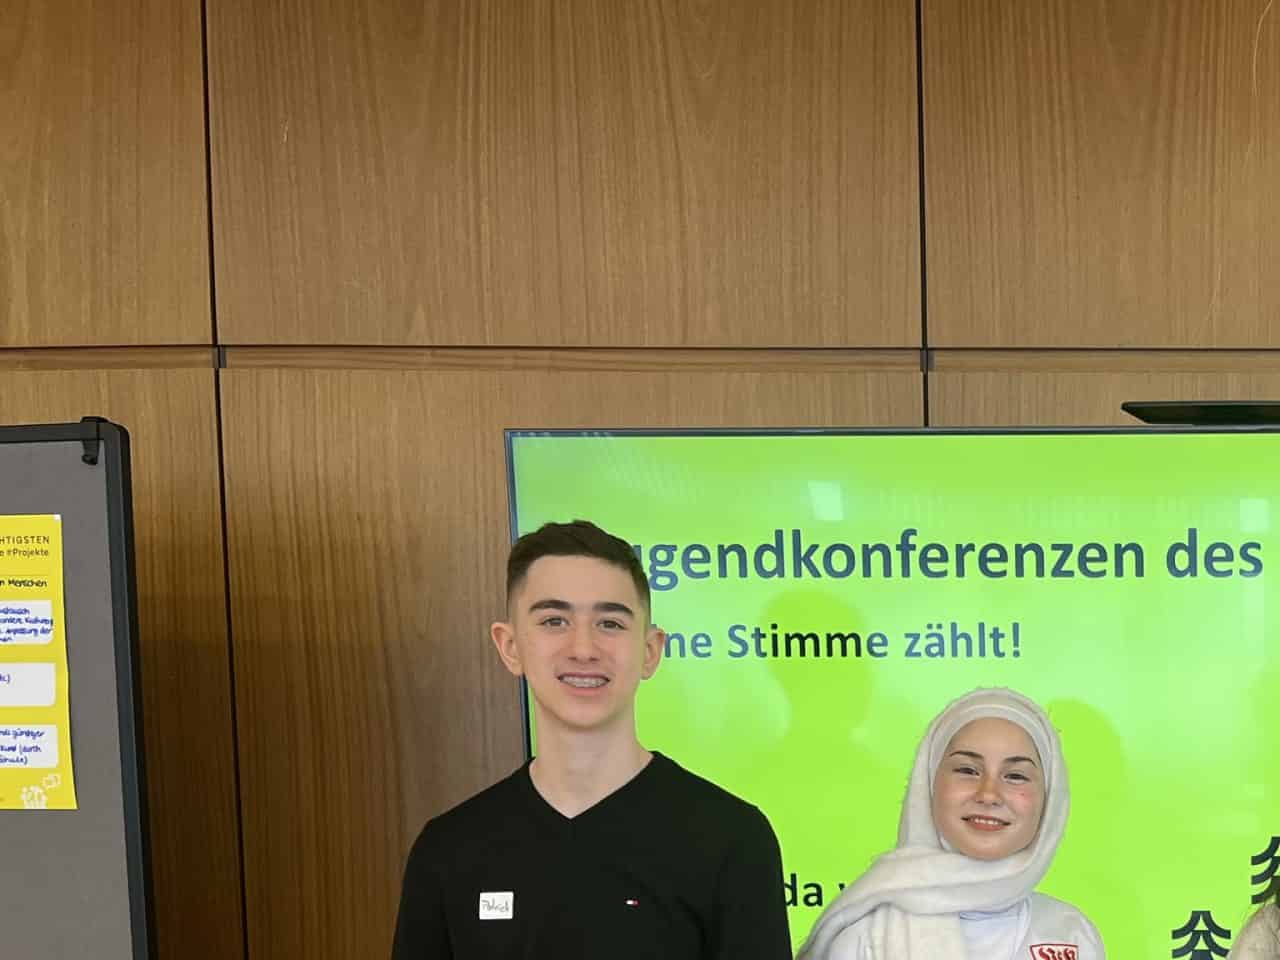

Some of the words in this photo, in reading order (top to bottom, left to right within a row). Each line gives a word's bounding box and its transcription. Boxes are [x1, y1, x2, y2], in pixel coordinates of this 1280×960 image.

[1166, 527, 1263, 578] des
[728, 623, 888, 658] Stimme
[904, 622, 1021, 658] zählt!
